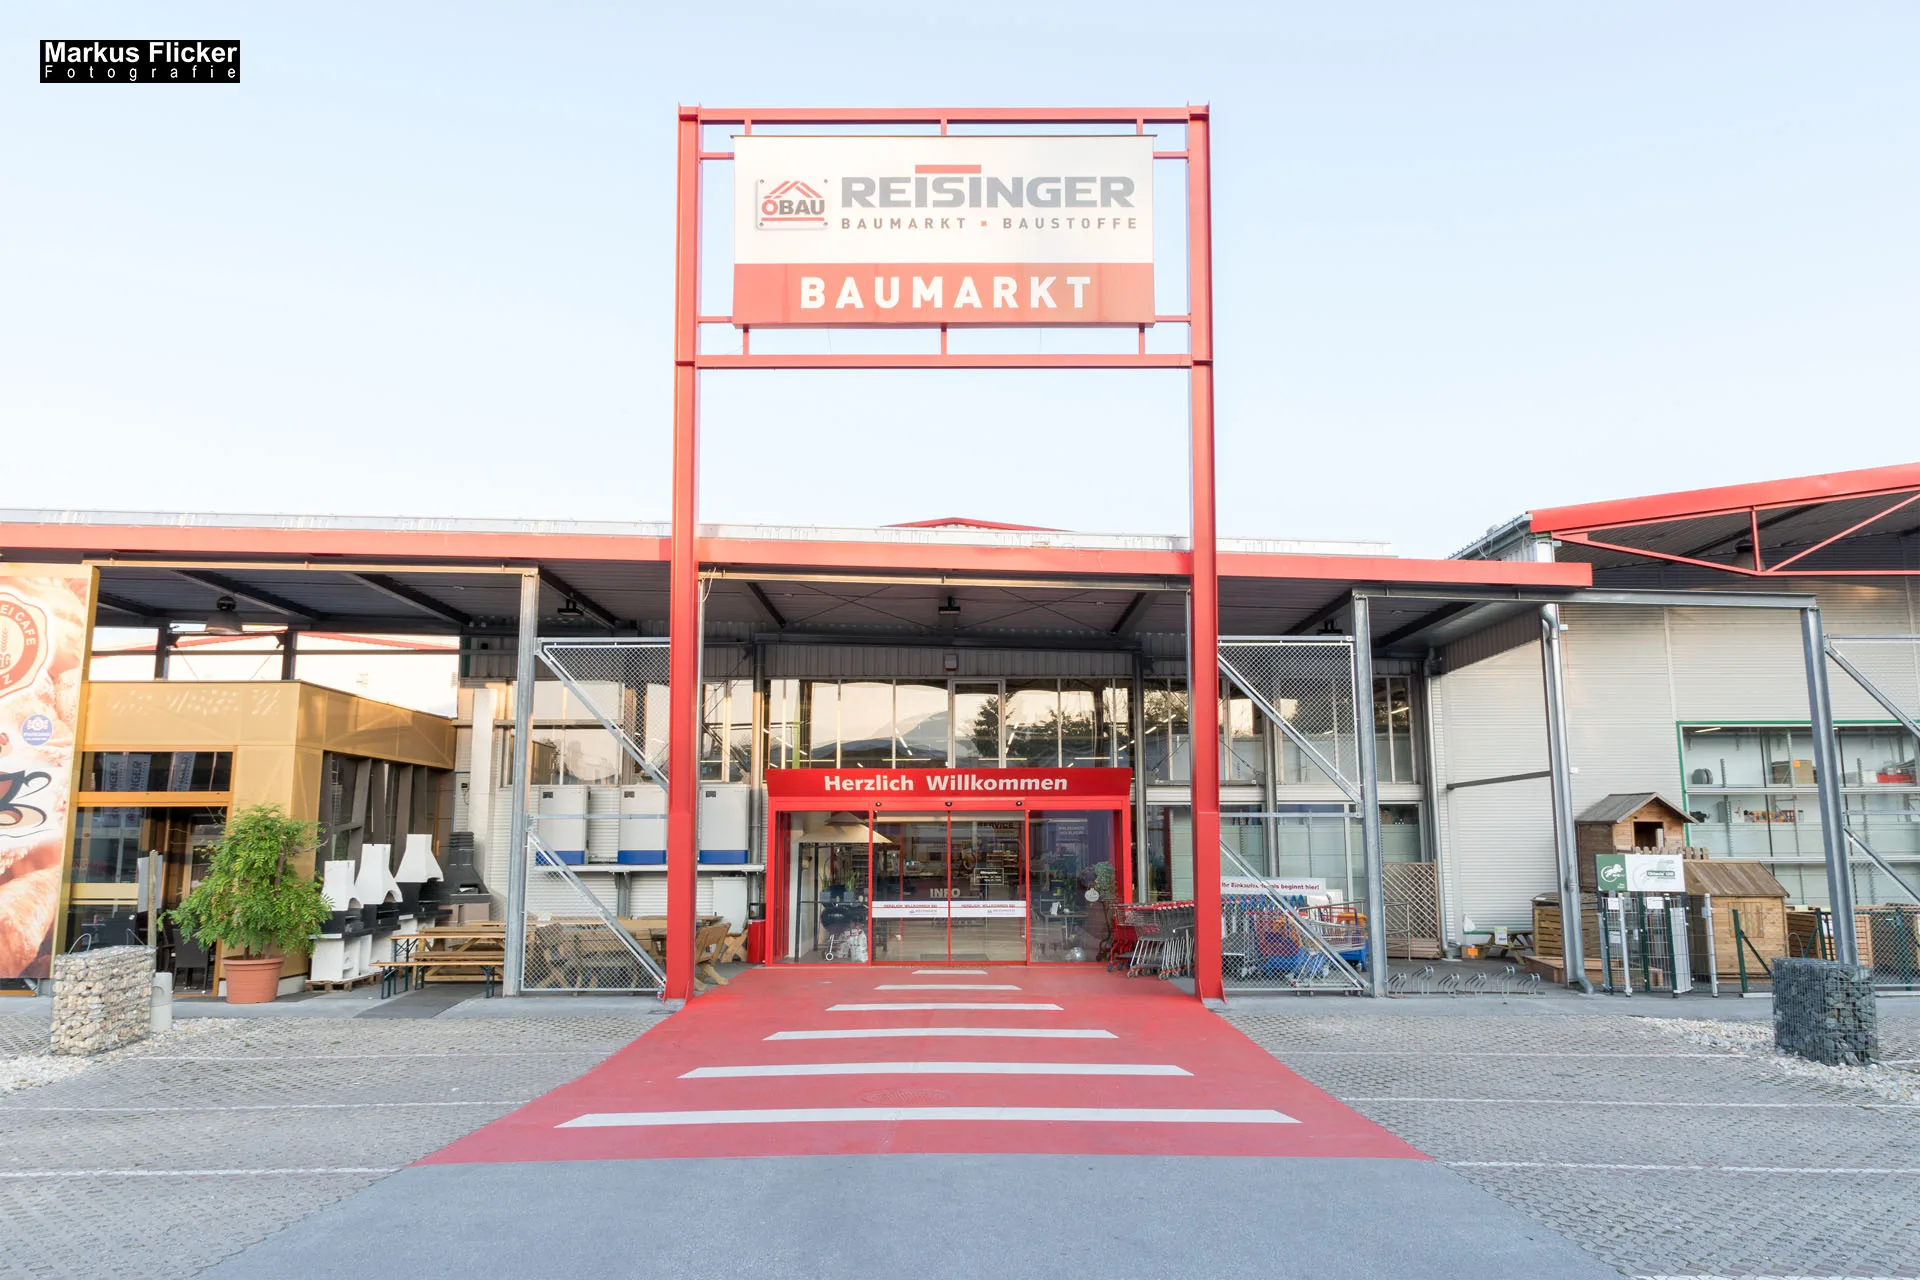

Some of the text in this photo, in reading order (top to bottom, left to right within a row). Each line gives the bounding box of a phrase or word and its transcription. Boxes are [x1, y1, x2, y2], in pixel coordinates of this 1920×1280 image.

[842, 176, 1135, 208] REISINGER
[841, 217, 1137, 230] BAUMARKT BAUSTOFFE
[800, 276, 1091, 309] BAUMARKT
[824, 775, 1068, 791] Herzlich Willkommen
[1280, 883, 1304, 891] beginnt
